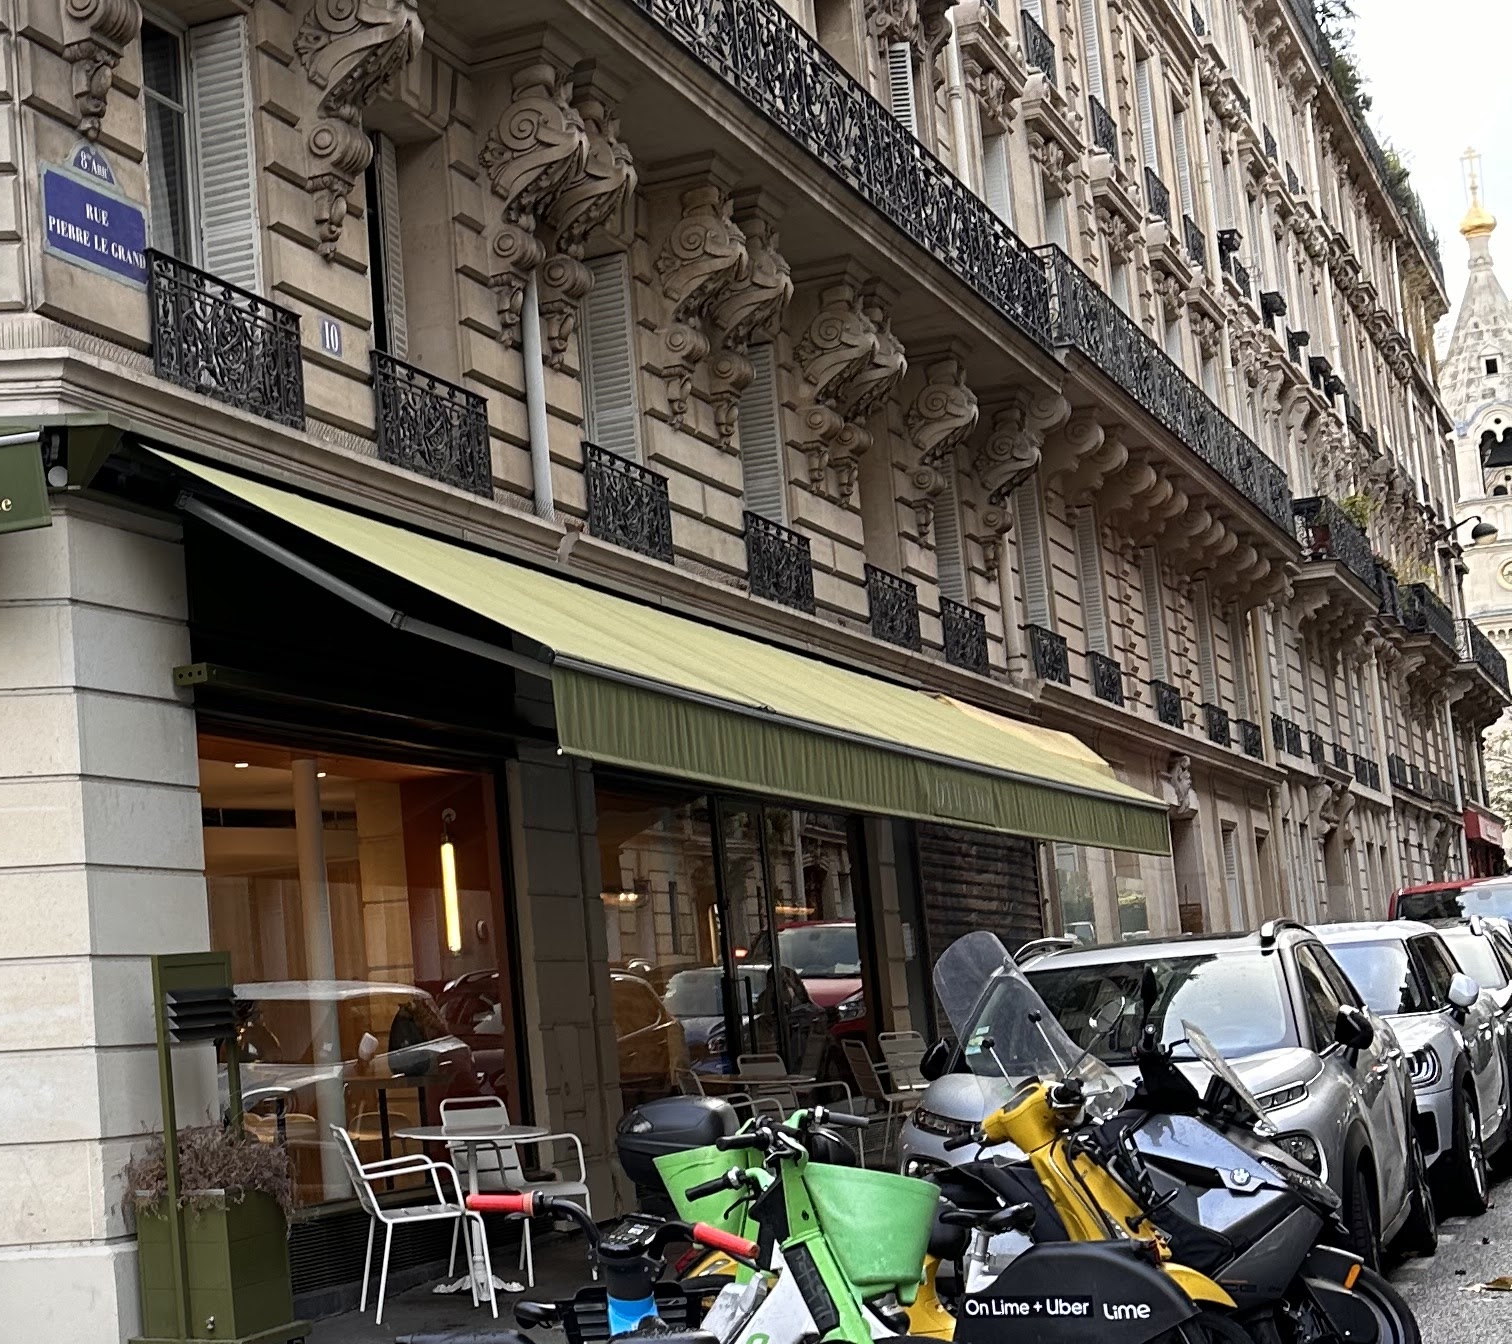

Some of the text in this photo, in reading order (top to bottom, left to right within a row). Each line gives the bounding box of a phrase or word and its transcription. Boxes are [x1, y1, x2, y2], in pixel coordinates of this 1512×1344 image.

[85, 203, 109, 227] RUE
[48, 215, 147, 270] PIERRE LE GRAND
[324, 320, 339, 353] 10
[965, 1299, 989, 1316] On
[991, 1299, 1030, 1316] Lime
[1045, 1298, 1090, 1316] Uber
[1103, 1303, 1151, 1320] Lime
